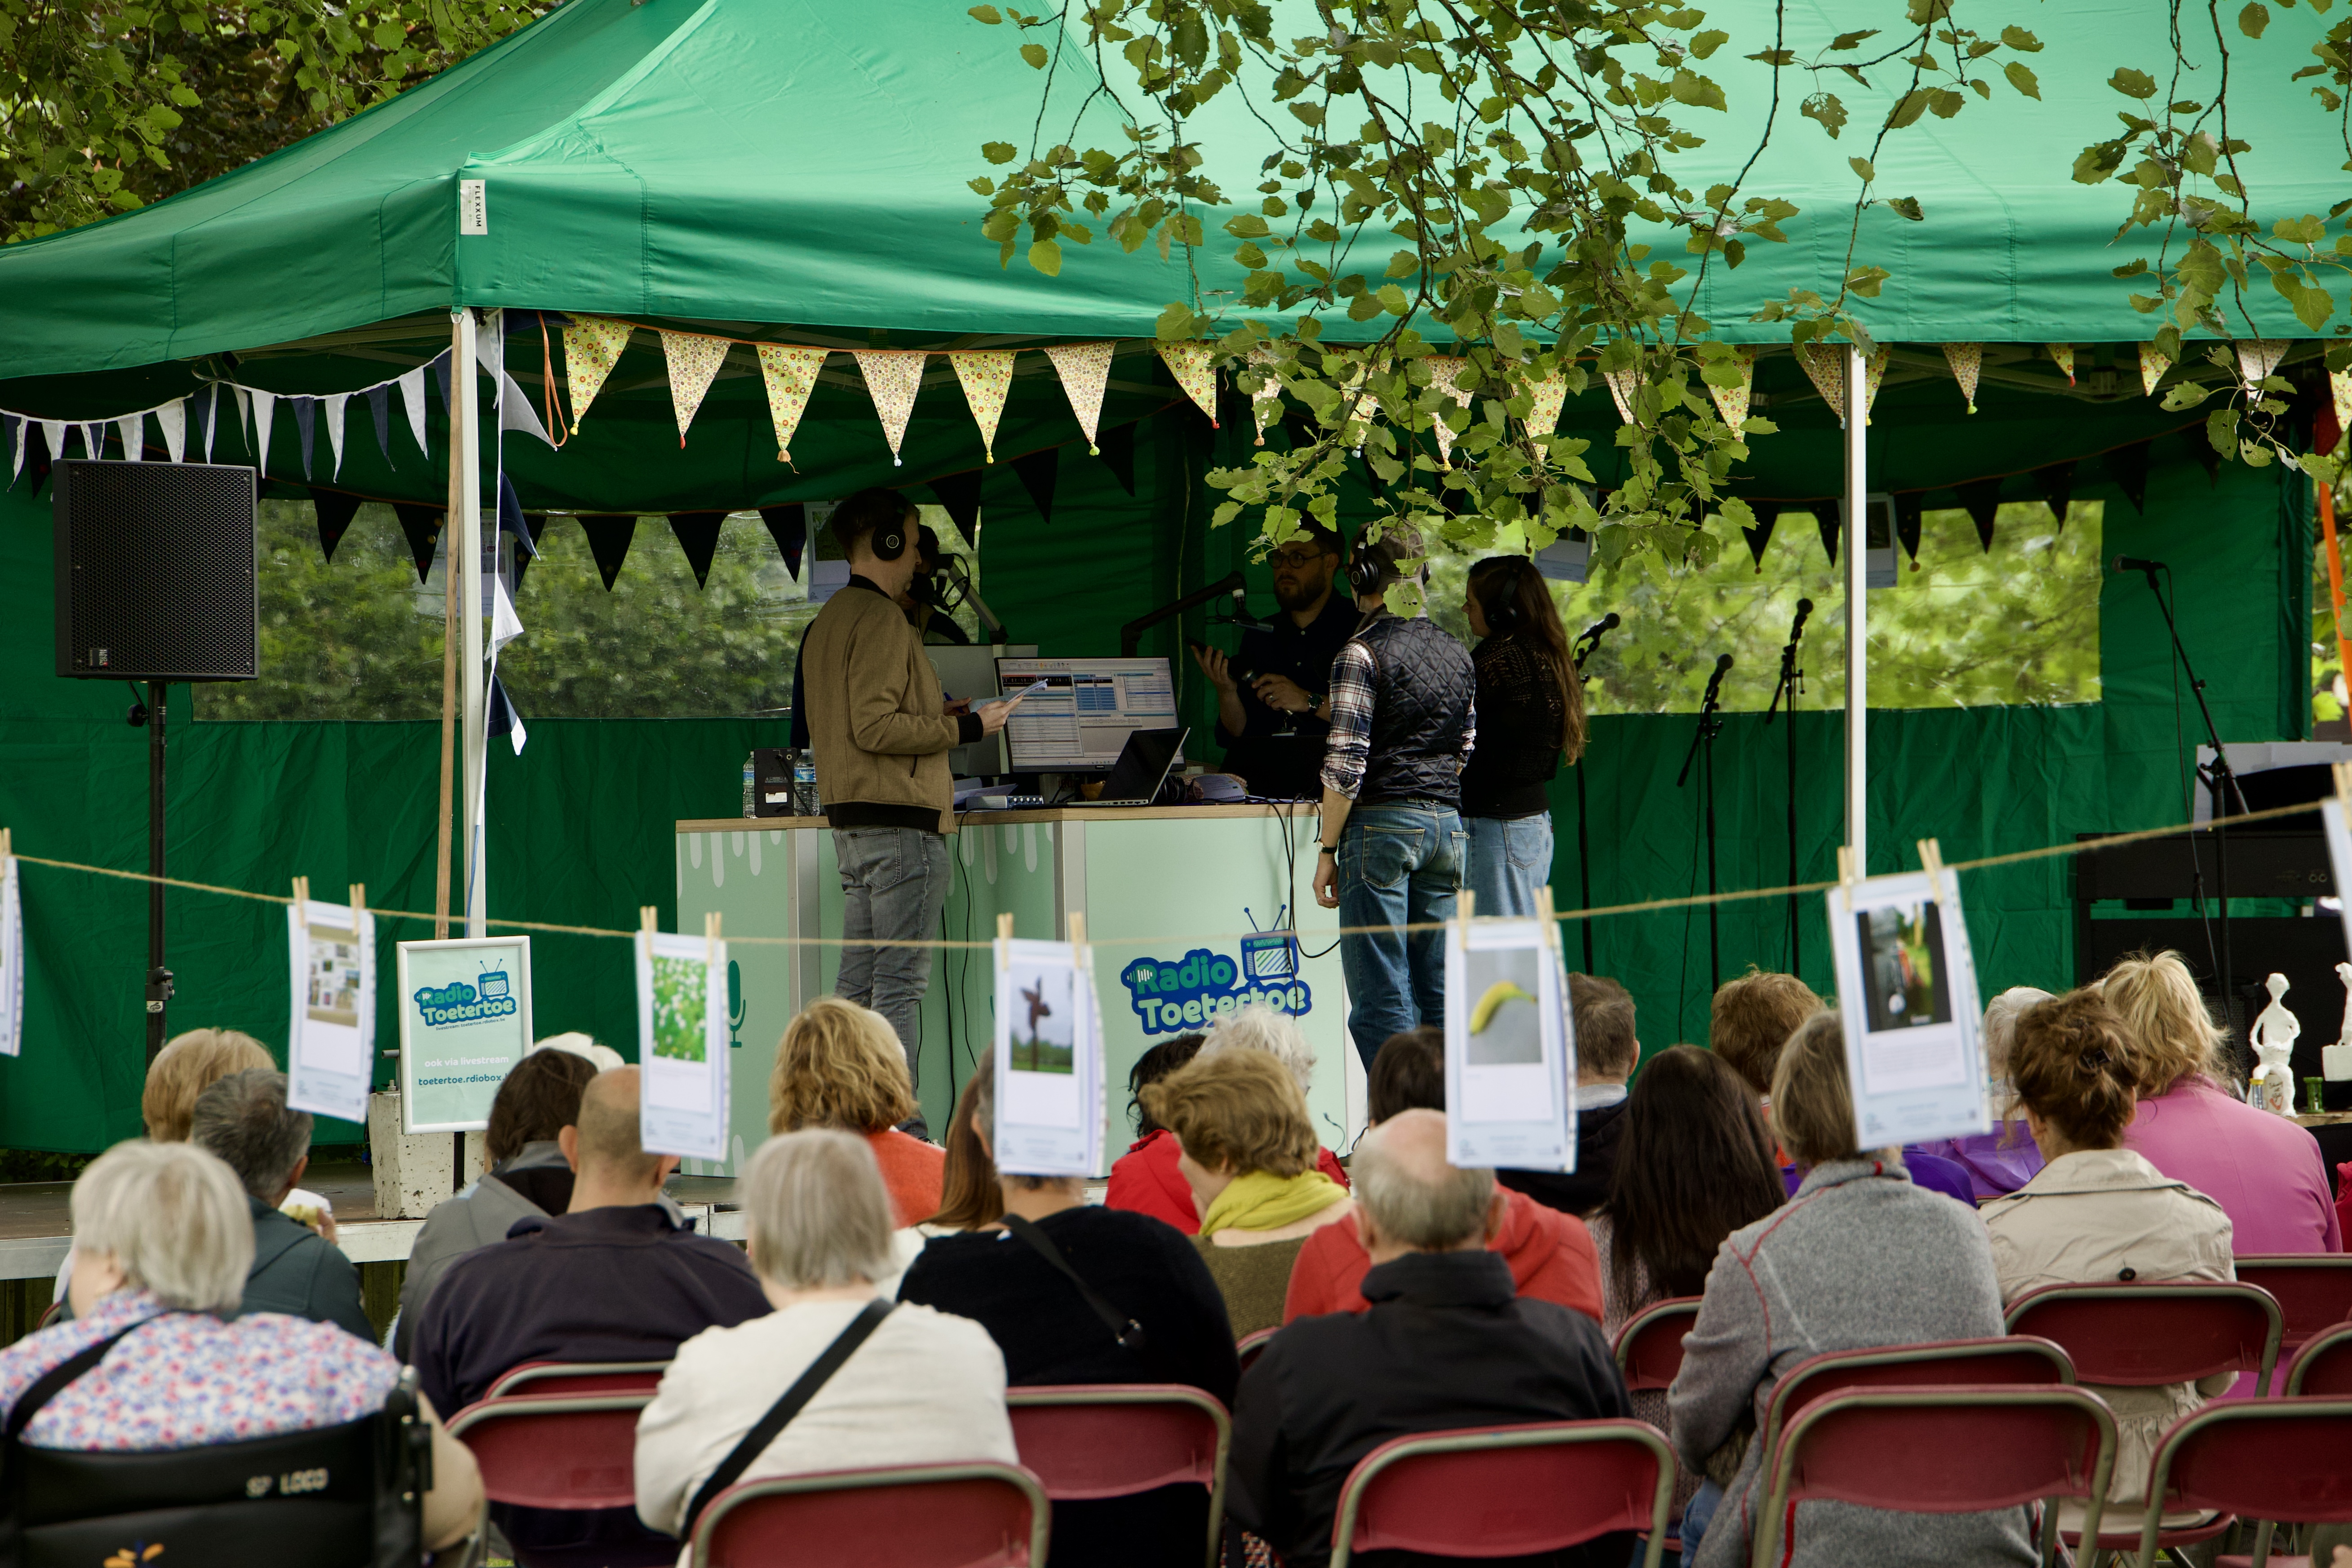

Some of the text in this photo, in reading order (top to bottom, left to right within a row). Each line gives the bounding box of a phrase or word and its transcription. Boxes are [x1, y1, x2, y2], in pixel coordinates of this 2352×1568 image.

[1133, 955, 1232, 995] Radio
[420, 985, 474, 1006] Radio
[423, 1000, 514, 1023] Toetertoe
[461, 1018, 505, 1028] toetertoe.rdiobox.be
[425, 1056, 509, 1067] ook via livestream
